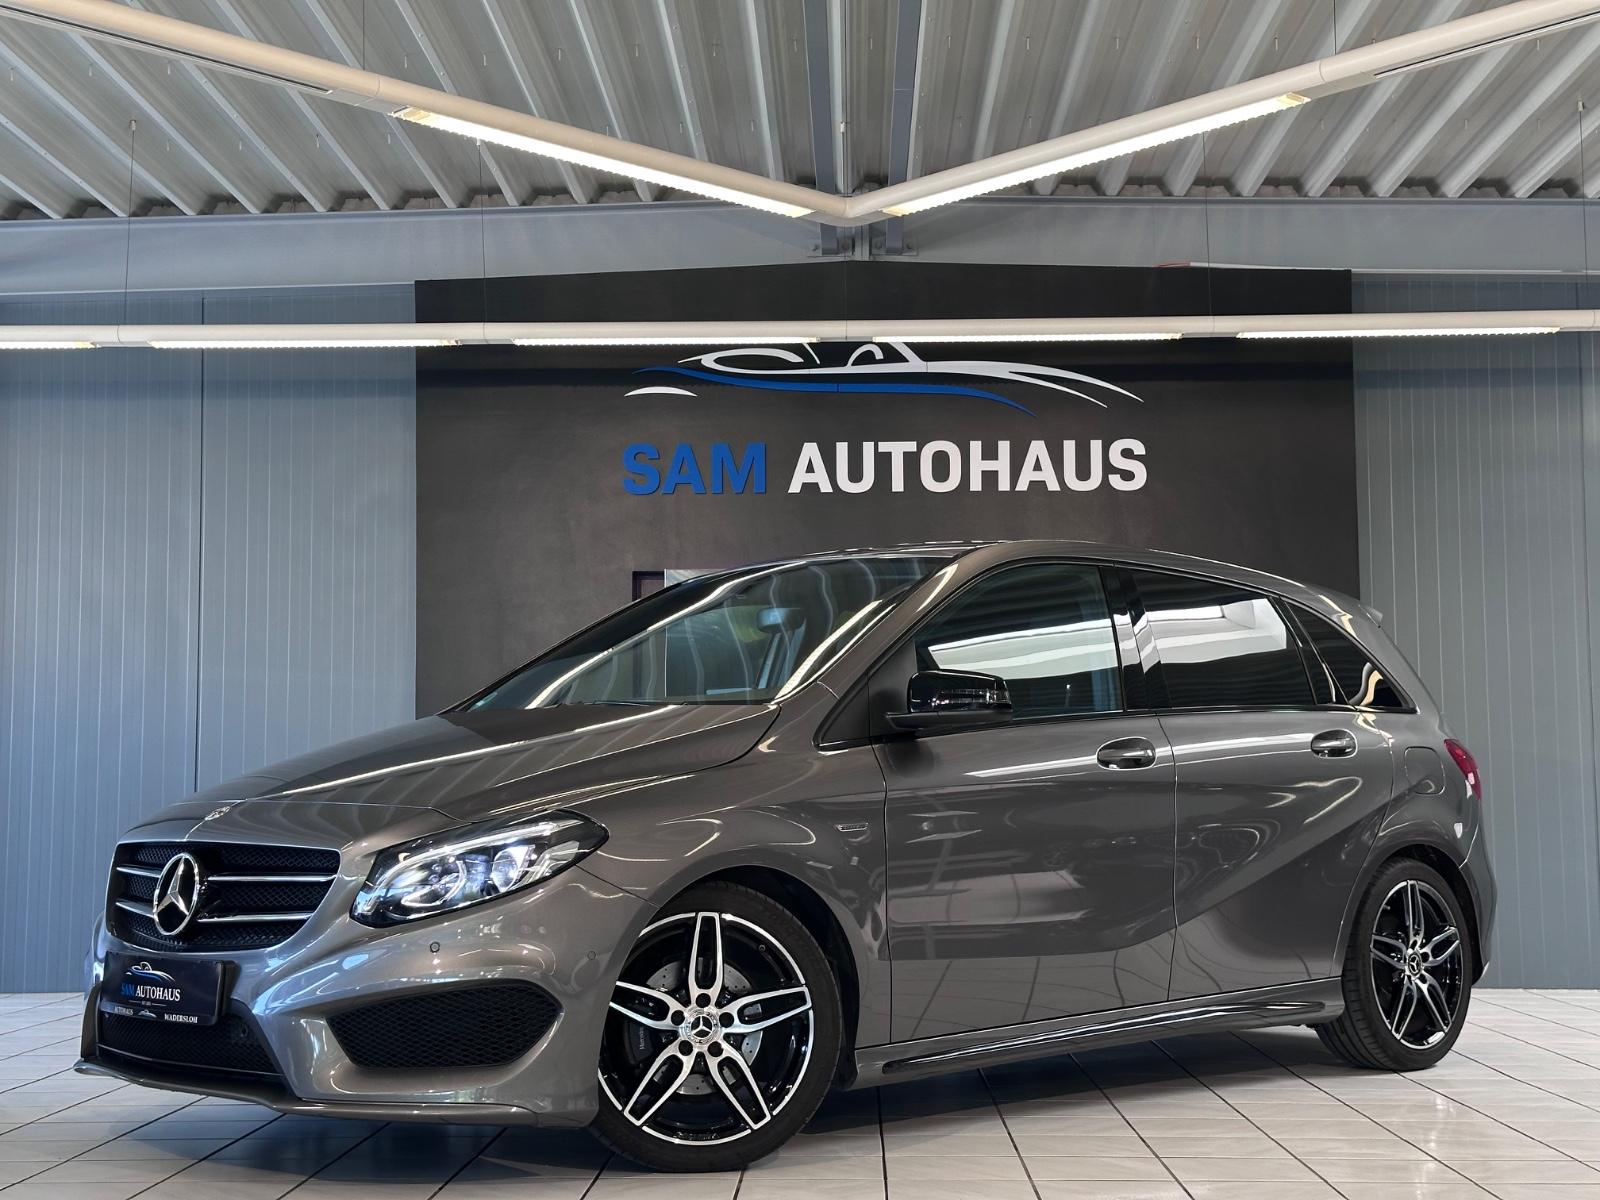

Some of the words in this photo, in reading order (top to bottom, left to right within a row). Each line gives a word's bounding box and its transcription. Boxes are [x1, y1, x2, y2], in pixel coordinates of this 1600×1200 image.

[622, 442, 767, 496] SAM
[787, 438, 1148, 495] AUTOHAUS
[135, 985, 181, 1002] AUTOHAUS
